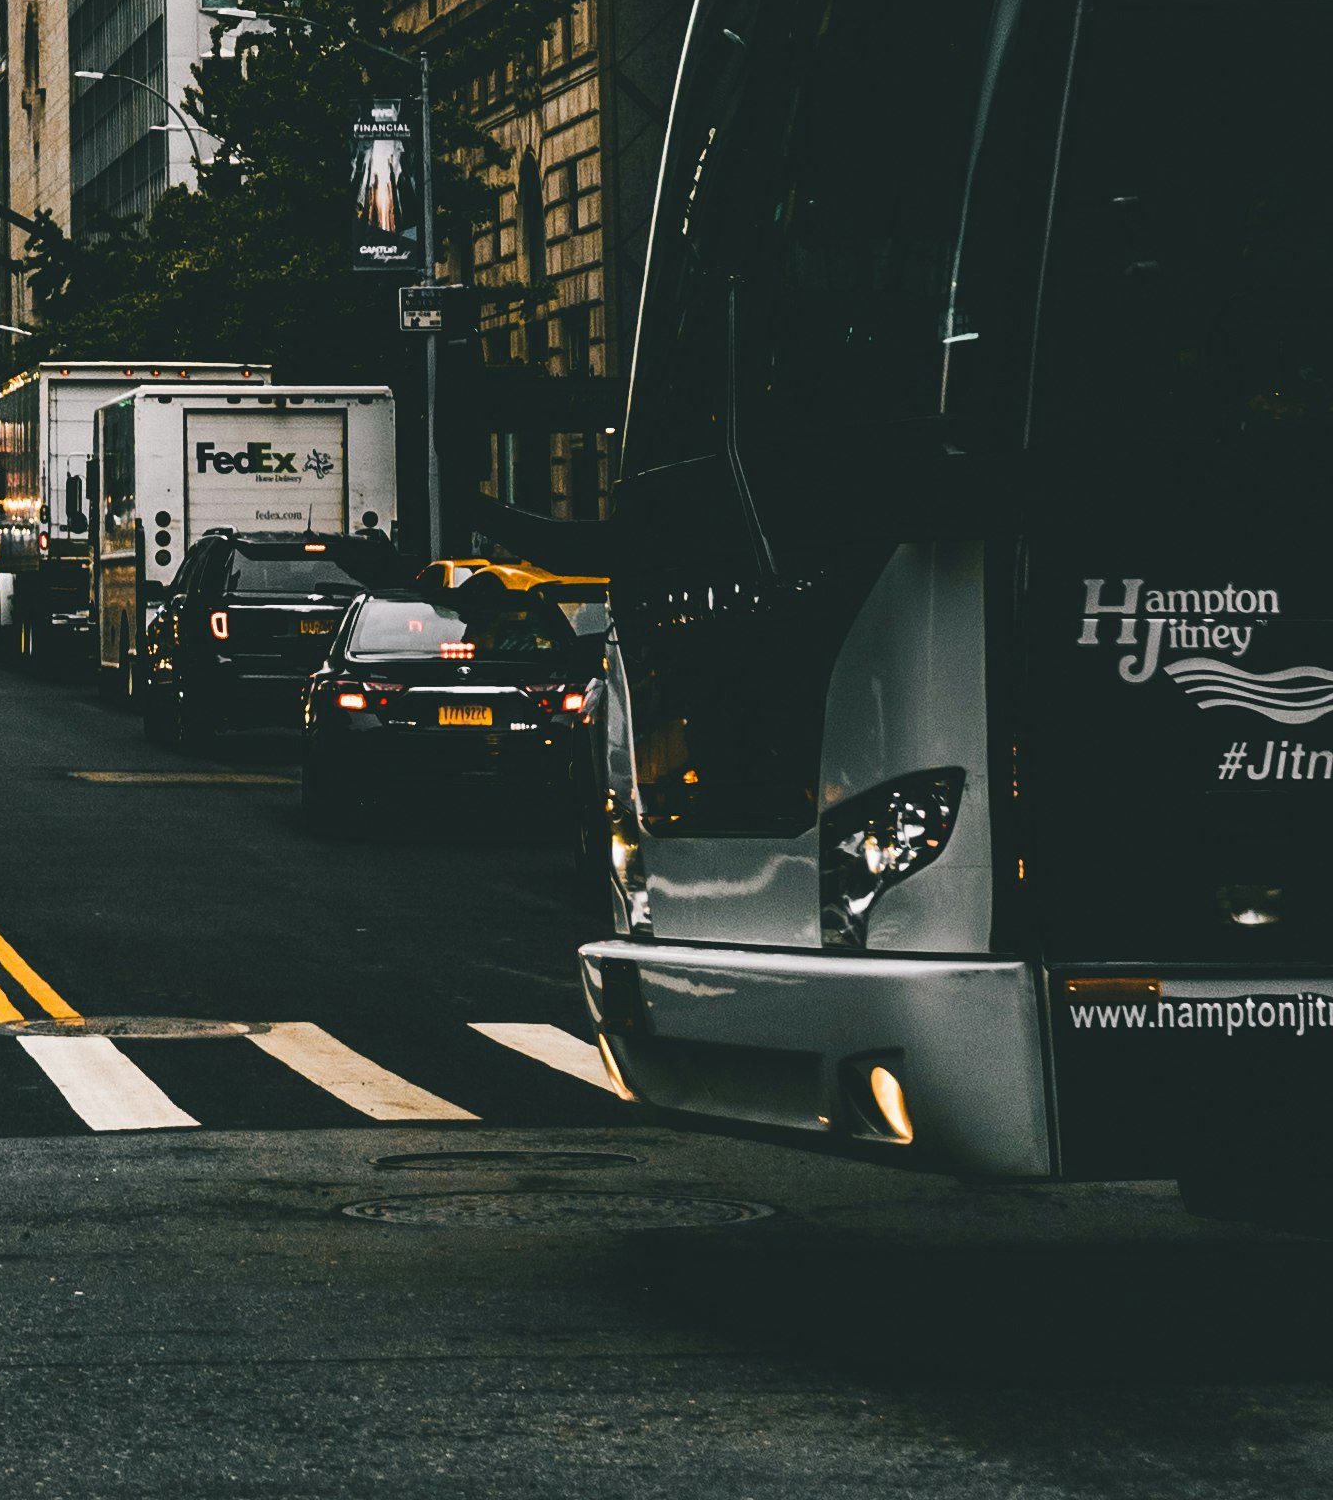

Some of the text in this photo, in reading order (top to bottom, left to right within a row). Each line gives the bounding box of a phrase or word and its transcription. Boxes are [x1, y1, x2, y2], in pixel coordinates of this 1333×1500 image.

[353, 123, 411, 132] FINANCIAL
[196, 442, 298, 474] FedEx
[255, 474, 302, 483] Home Delivery
[255, 510, 303, 520] fedex.com
[1076, 578, 1282, 645] Hampton
[1118, 618, 1254, 684] Jitney
[1069, 993, 1333, 1037] www.hamptonjit
